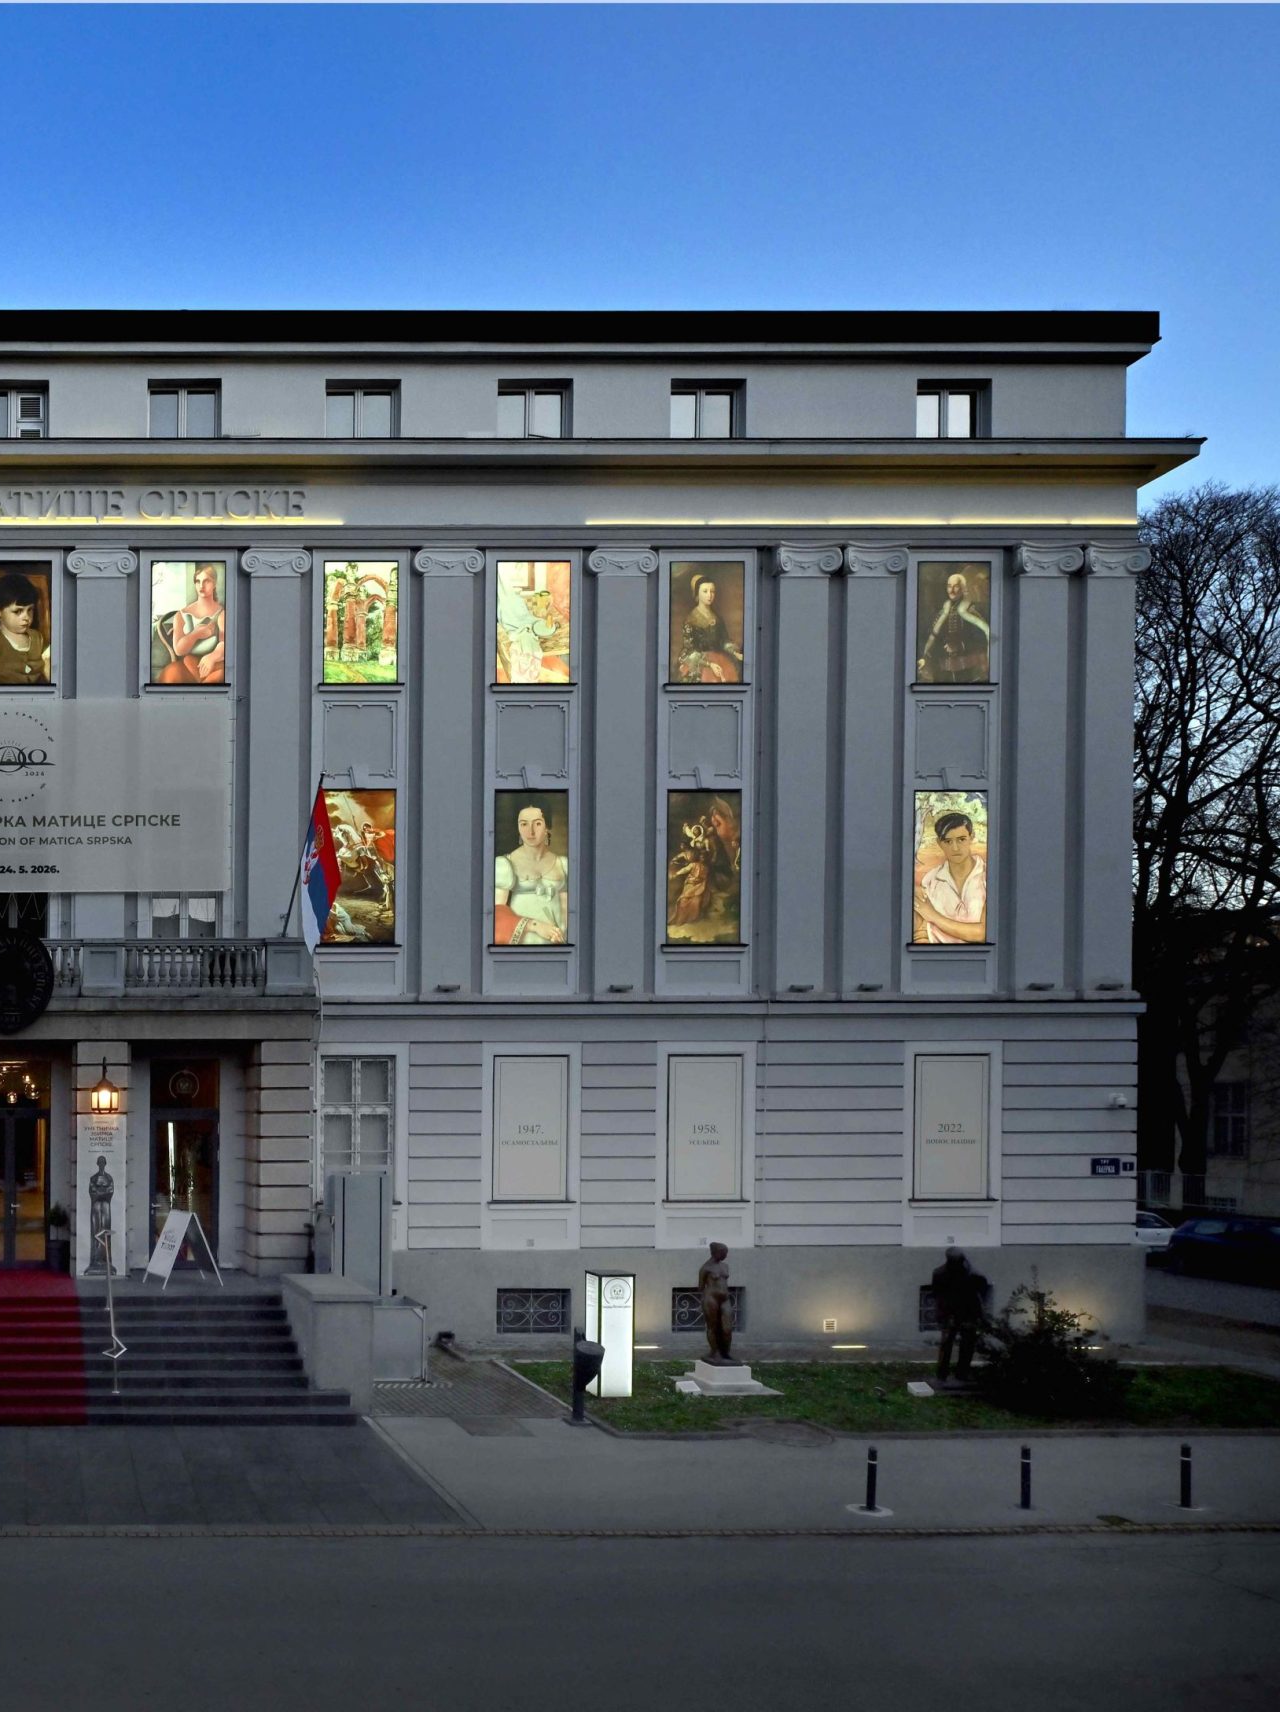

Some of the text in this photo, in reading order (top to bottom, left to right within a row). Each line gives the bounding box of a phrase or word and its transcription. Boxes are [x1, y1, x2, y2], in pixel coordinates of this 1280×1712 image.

[139, 490, 306, 520] СРПСКЕ
[32, 815, 107, 829] МАТИЦЕ
[111, 814, 181, 827] СРПСКЕ
[19, 837, 36, 845] OF
[39, 836, 84, 845] MATICA
[86, 836, 133, 845] SRPSKA
[0, 865, 16, 874] 24.
[18, 865, 28, 874] 5.
[30, 865, 60, 874] 2026.
[517, 1124, 544, 1134] 1947.
[692, 1123, 719, 1134] 1958.
[937, 1123, 965, 1133] 2022.
